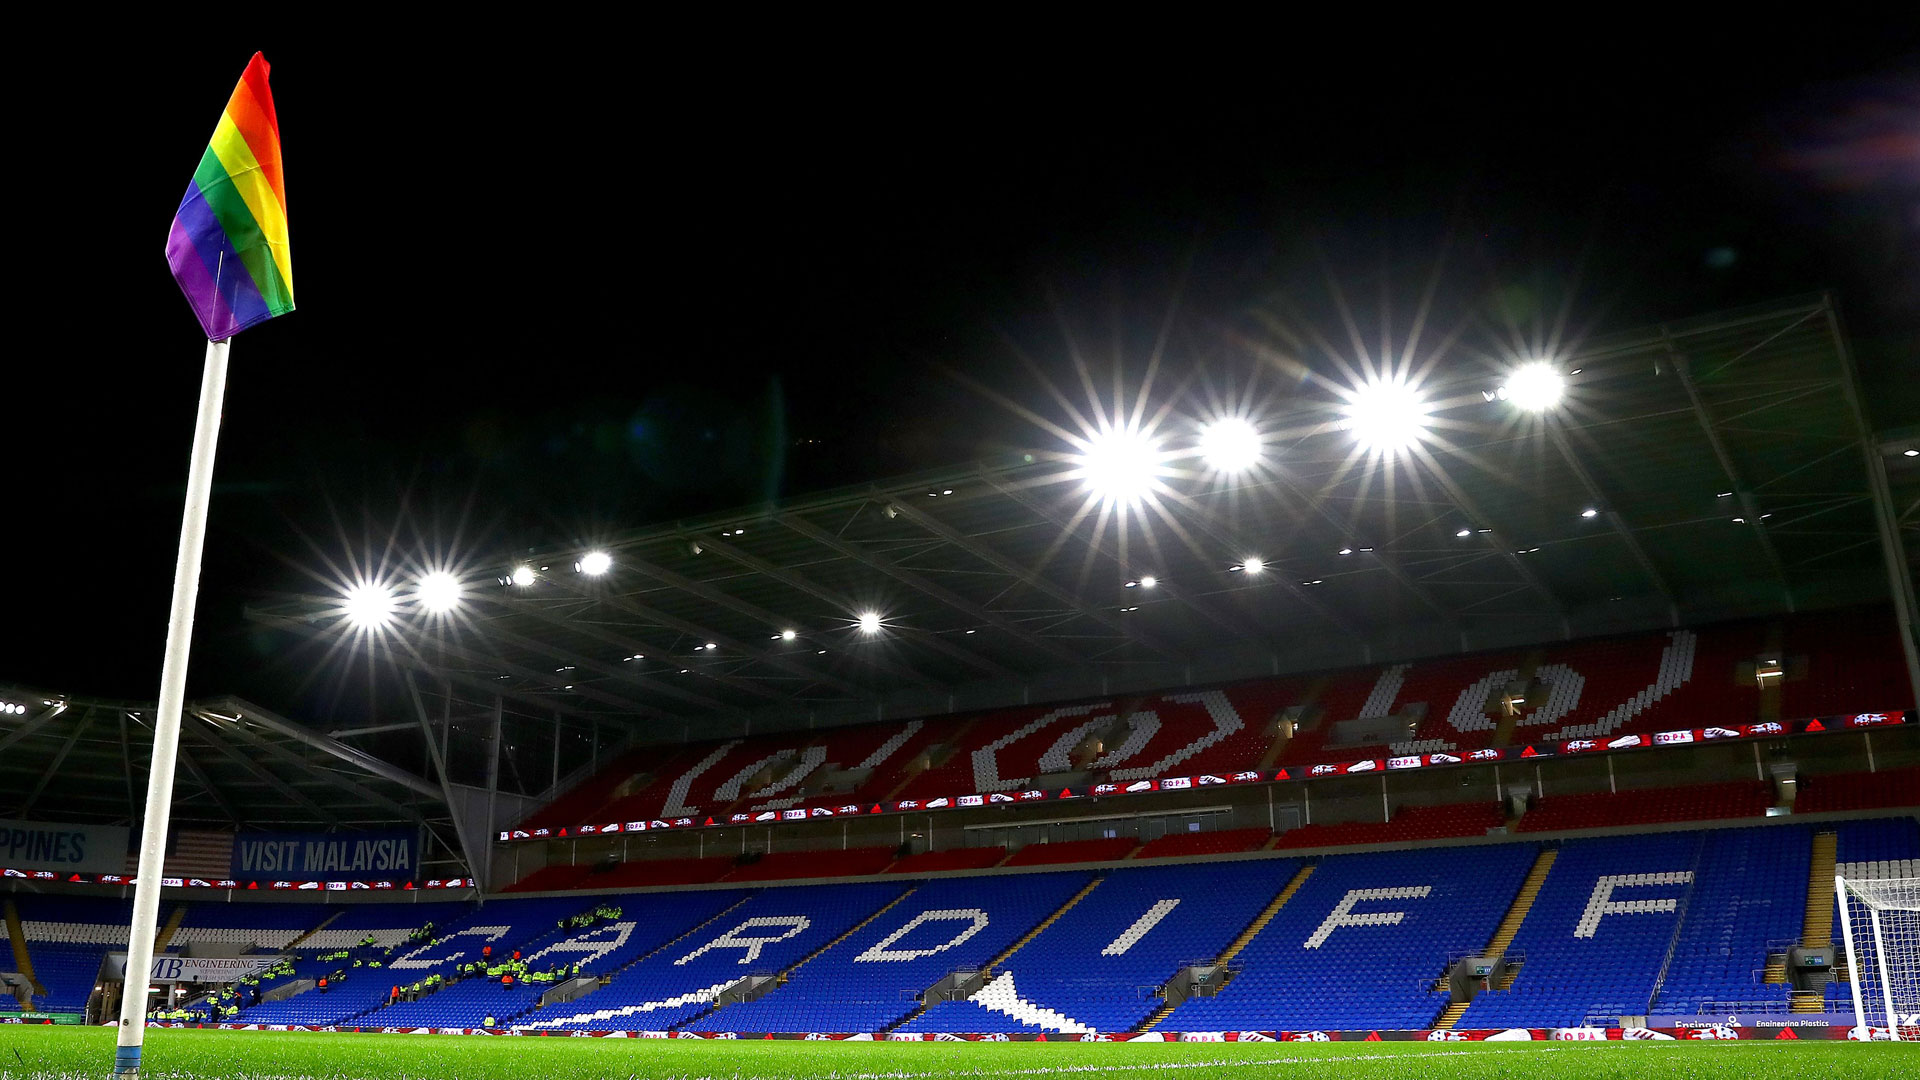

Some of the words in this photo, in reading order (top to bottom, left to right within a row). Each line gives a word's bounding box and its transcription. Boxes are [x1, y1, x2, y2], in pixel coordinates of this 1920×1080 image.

[1657, 732, 1687, 742] COPA
[1390, 758, 1414, 767] COPA
[241, 841, 299, 872] VISIT
[304, 839, 410, 872] MALAYSIA
[184, 959, 254, 969] ENGINEERING
[1556, 1032, 1596, 1040] COPA
